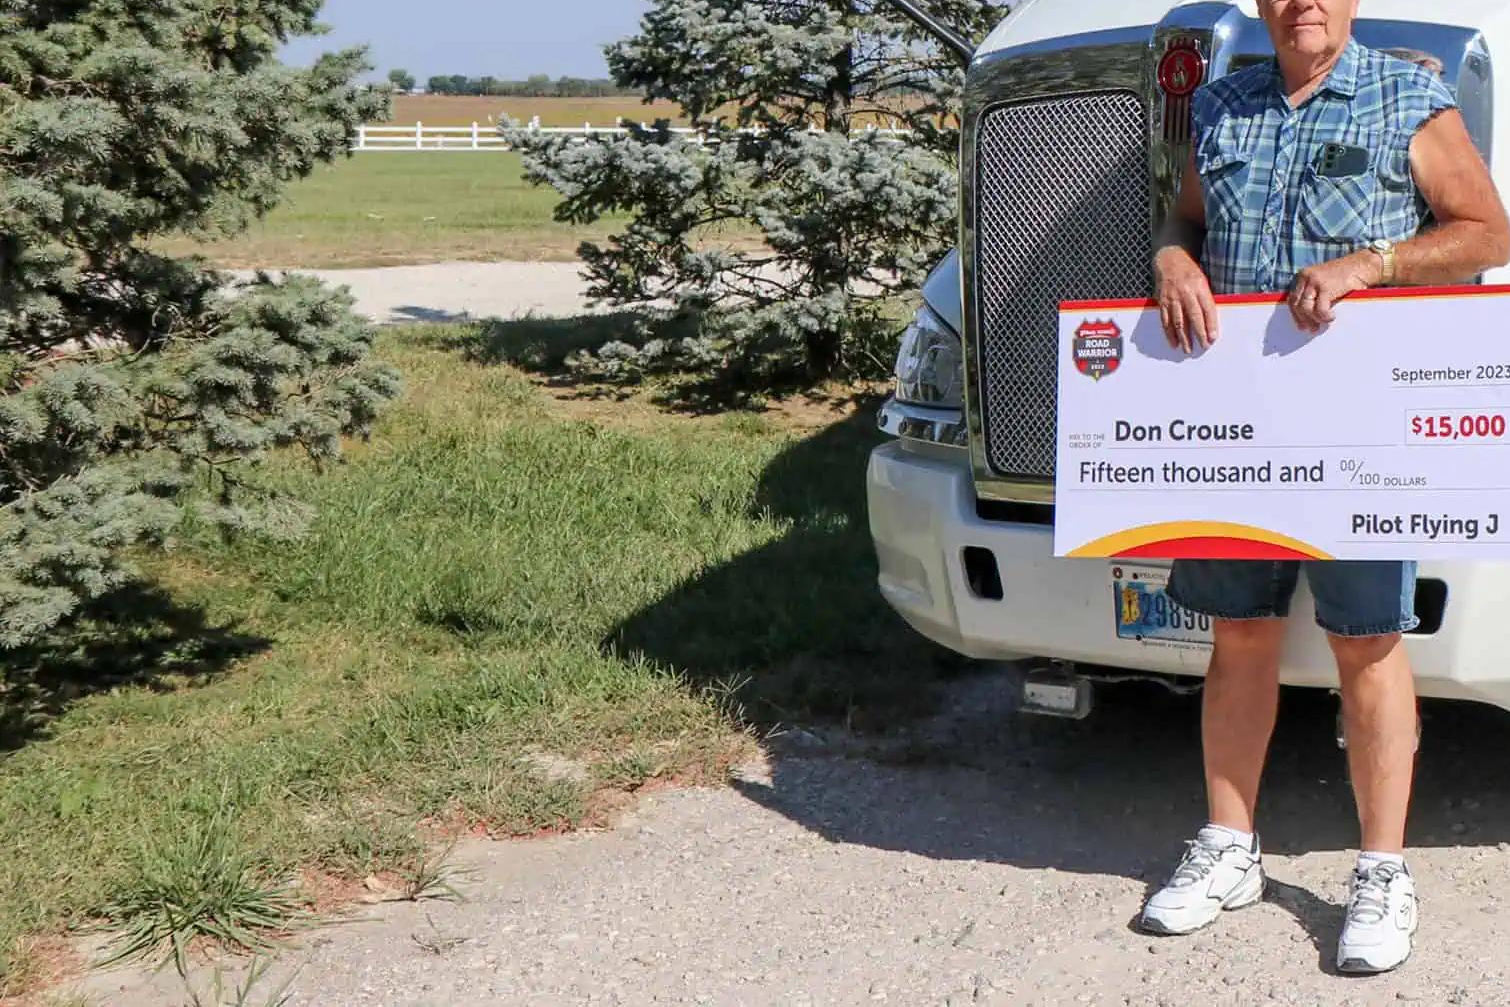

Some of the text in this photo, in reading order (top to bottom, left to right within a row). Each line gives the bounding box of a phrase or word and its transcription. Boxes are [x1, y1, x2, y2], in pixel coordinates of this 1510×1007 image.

[1077, 348, 1117, 358] WARRIOR
[1085, 339, 1110, 348] ROAD
[1392, 366, 1472, 384] September
[1114, 419, 1255, 441] Don Crouse
[1411, 415, 1506, 440] $15,000
[1079, 461, 1155, 483] Fifteen
[1162, 460, 1272, 483] thousand
[1279, 459, 1325, 483] and
[1384, 476, 1427, 487] DOLLARS
[1352, 513, 1499, 540] Pilot Flying J
